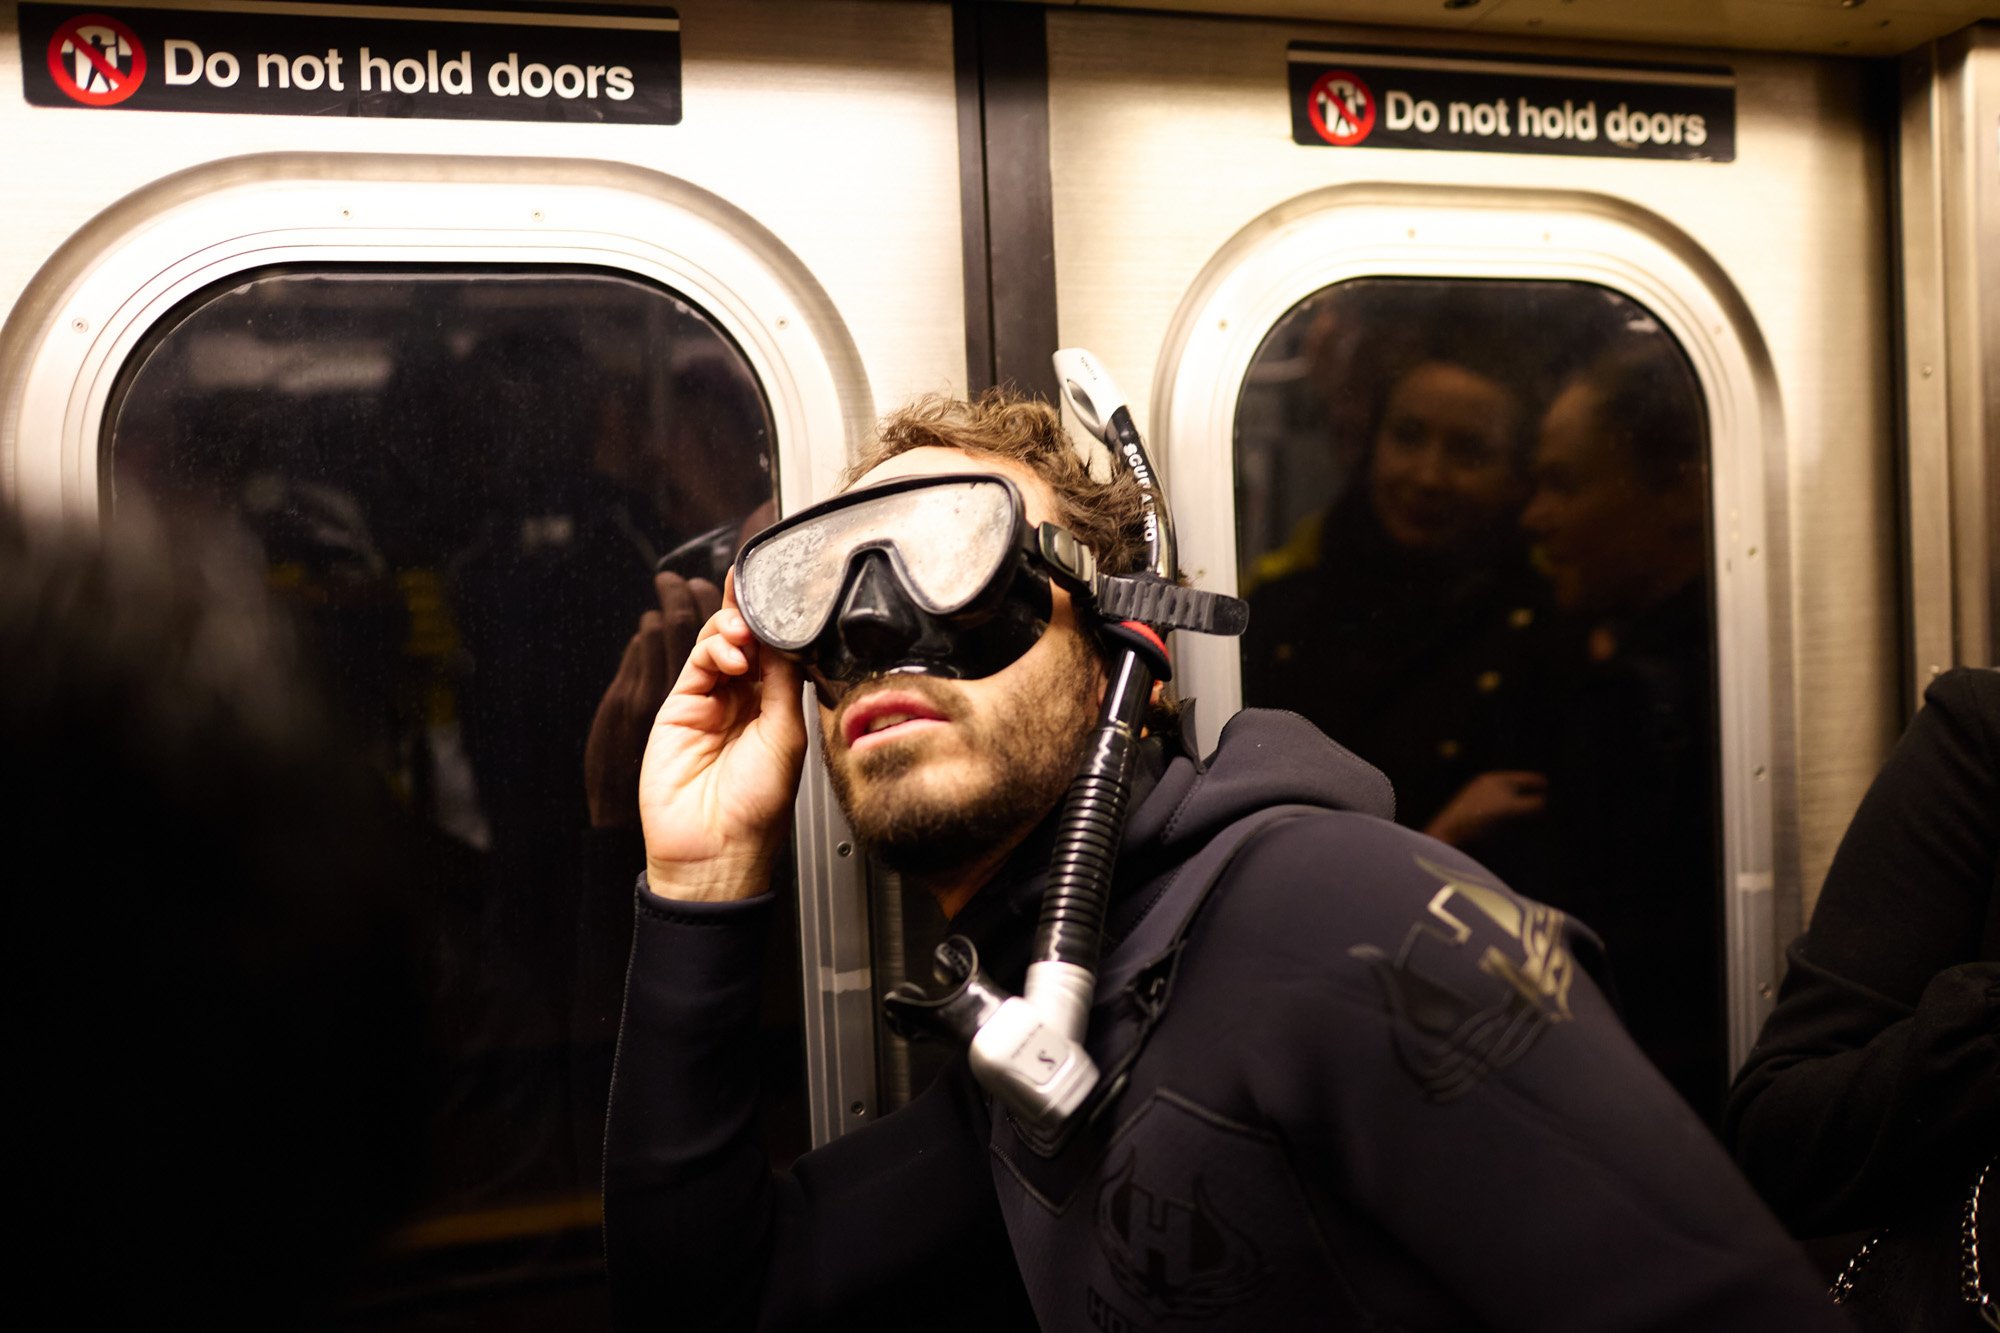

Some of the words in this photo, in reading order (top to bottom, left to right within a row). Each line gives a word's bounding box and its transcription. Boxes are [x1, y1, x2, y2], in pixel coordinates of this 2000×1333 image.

[164, 40, 241, 88] Do
[257, 49, 345, 92] not
[360, 47, 473, 96] hold
[487, 53, 635, 101] doors
[1385, 91, 1441, 134] Do
[1448, 99, 1512, 137] not
[1517, 98, 1599, 142] hold
[1604, 104, 1708, 148] doors
